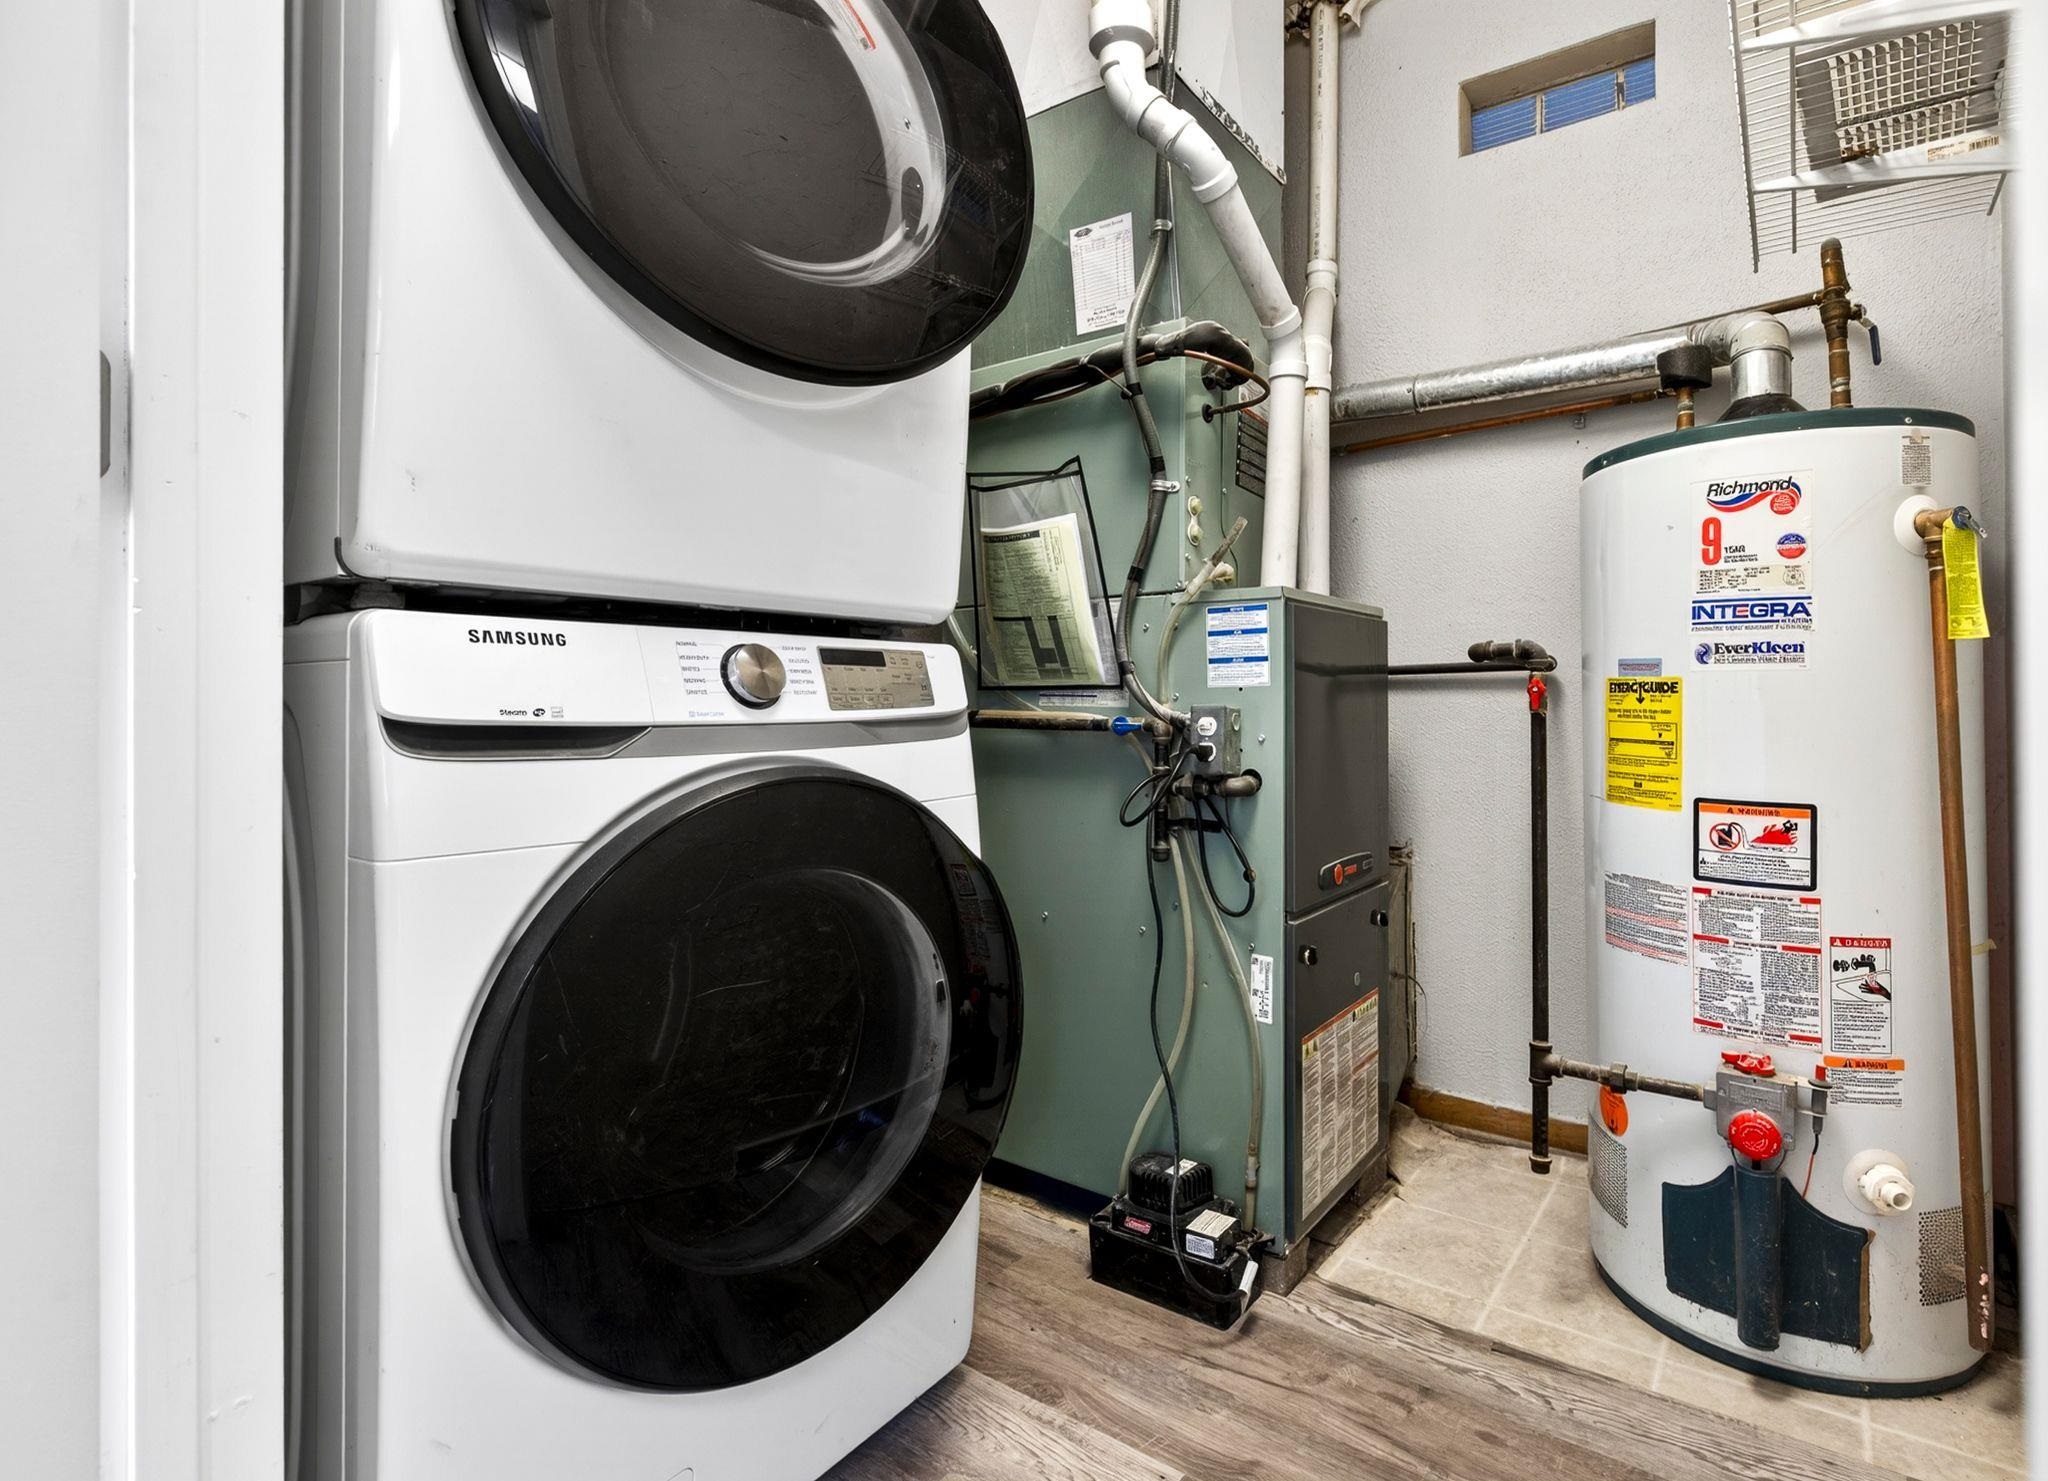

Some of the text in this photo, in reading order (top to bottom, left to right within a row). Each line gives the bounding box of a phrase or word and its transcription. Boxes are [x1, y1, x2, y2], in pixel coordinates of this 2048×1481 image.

[1706, 476, 1792, 497] Richmond
[1702, 517, 1722, 566] 9
[1692, 602, 1812, 620] INTEGRA
[468, 629, 567, 647] SAMSUNG
[1714, 641, 1805, 654] EverKleen
